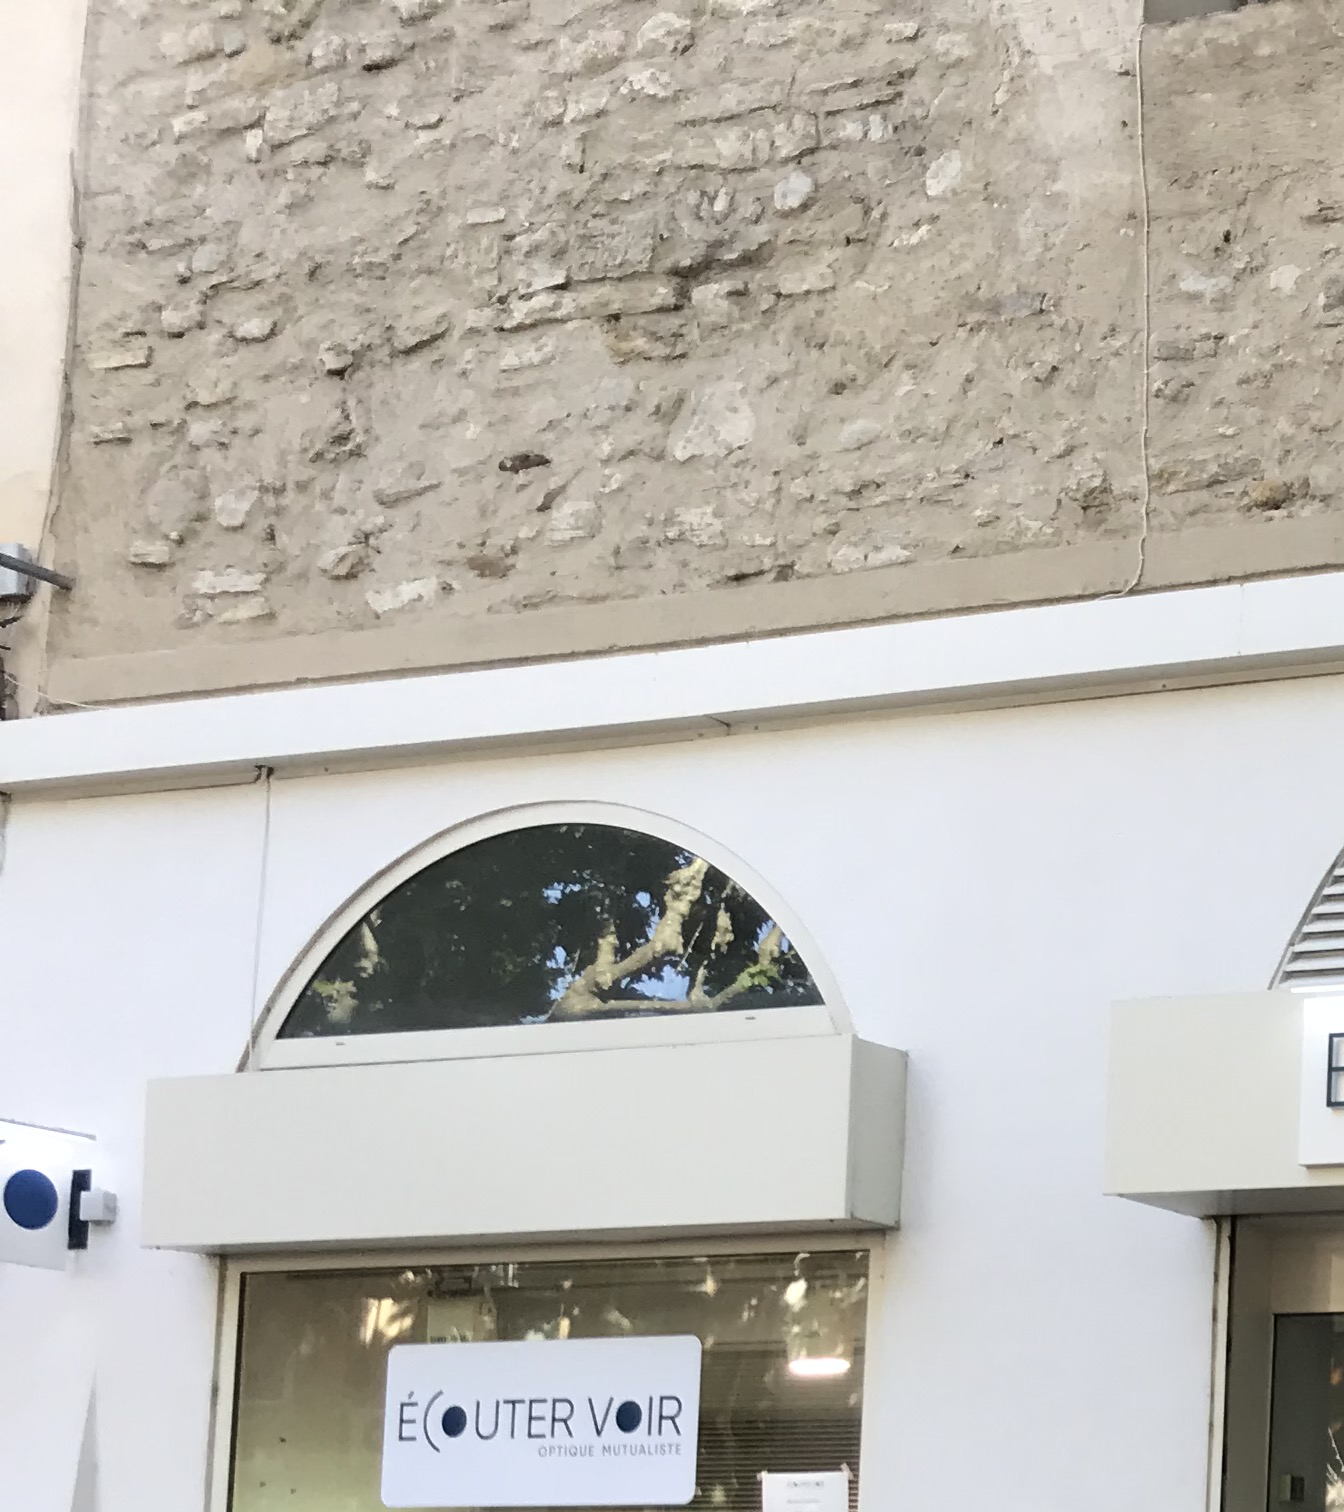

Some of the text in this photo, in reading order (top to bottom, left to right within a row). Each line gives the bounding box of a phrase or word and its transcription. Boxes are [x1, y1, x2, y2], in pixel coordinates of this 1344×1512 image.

[398, 1389, 683, 1453] ÉCOUTER VOIR
[538, 1443, 682, 1458] OPTIQUE MUTUALISTE
